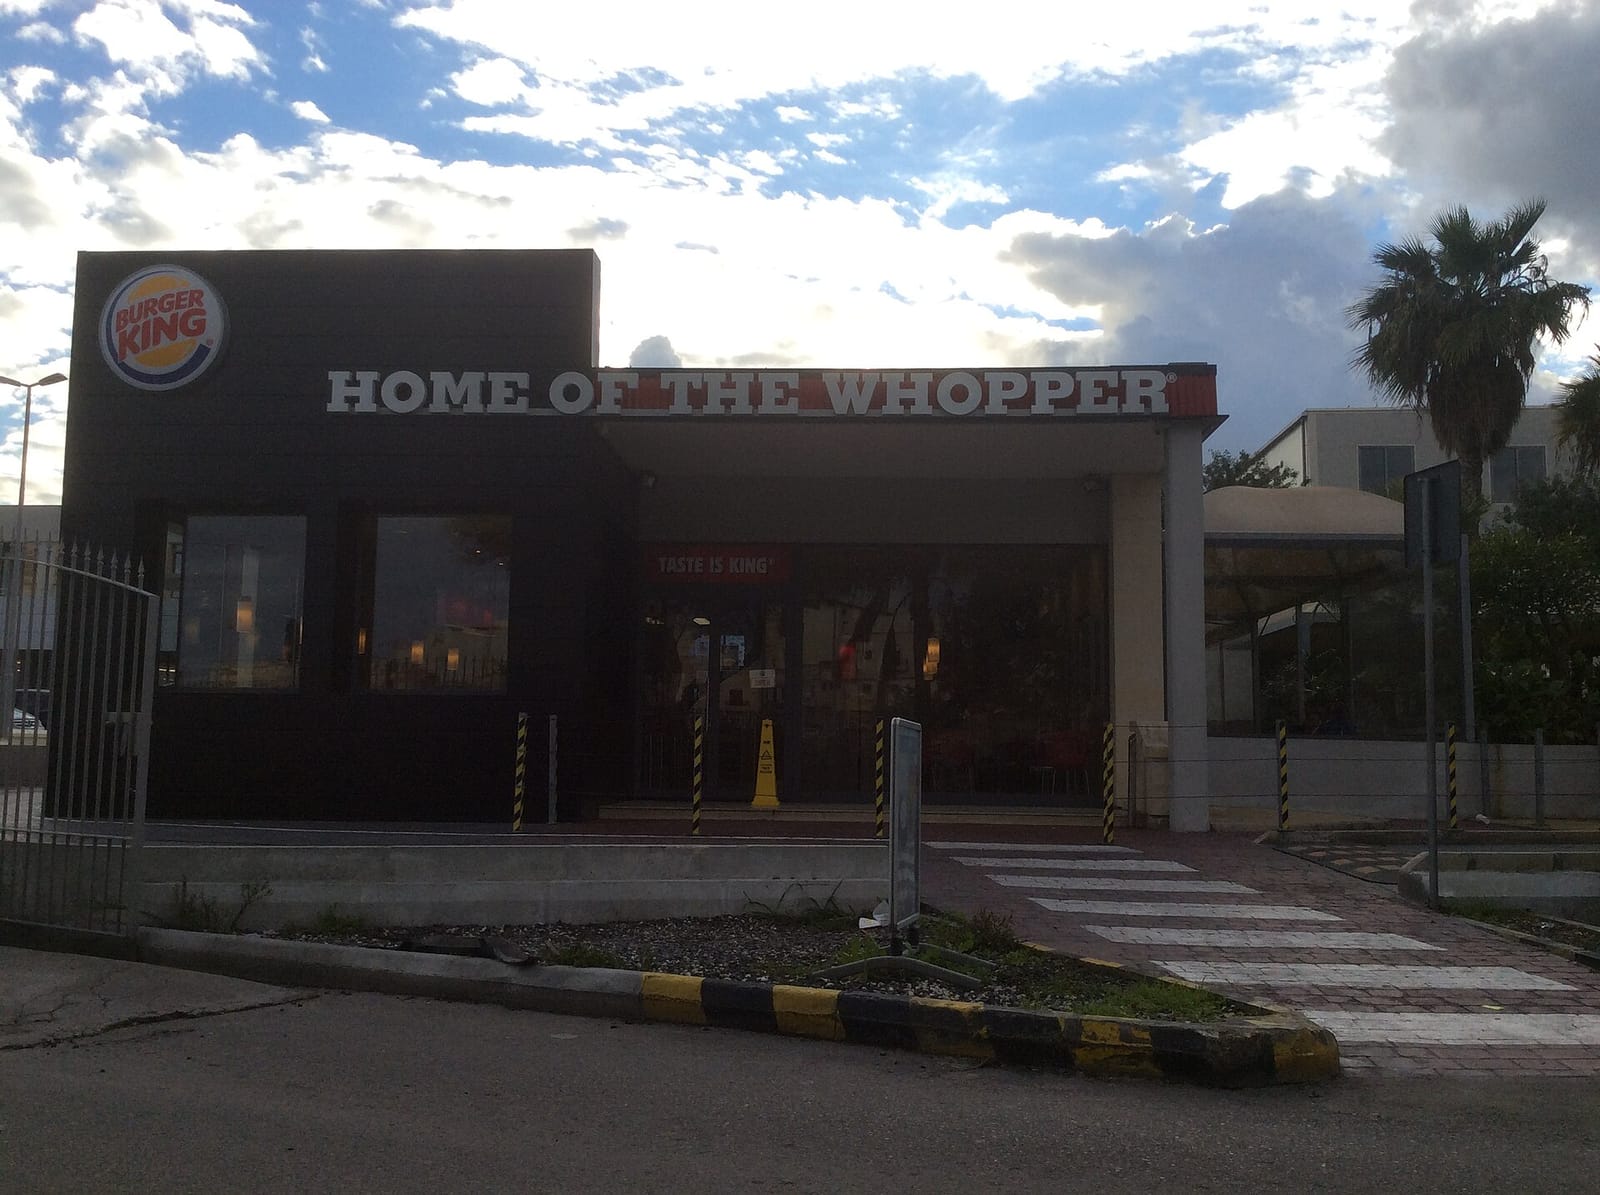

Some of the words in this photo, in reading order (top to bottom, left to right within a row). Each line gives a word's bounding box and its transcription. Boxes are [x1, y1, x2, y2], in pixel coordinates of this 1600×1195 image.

[115, 289, 205, 332] BURGER
[118, 308, 207, 361] KING
[326, 370, 530, 414] HOME
[549, 371, 639, 414] OF
[660, 372, 799, 415] THE
[658, 556, 704, 574] TASTE
[709, 557, 723, 574] IS
